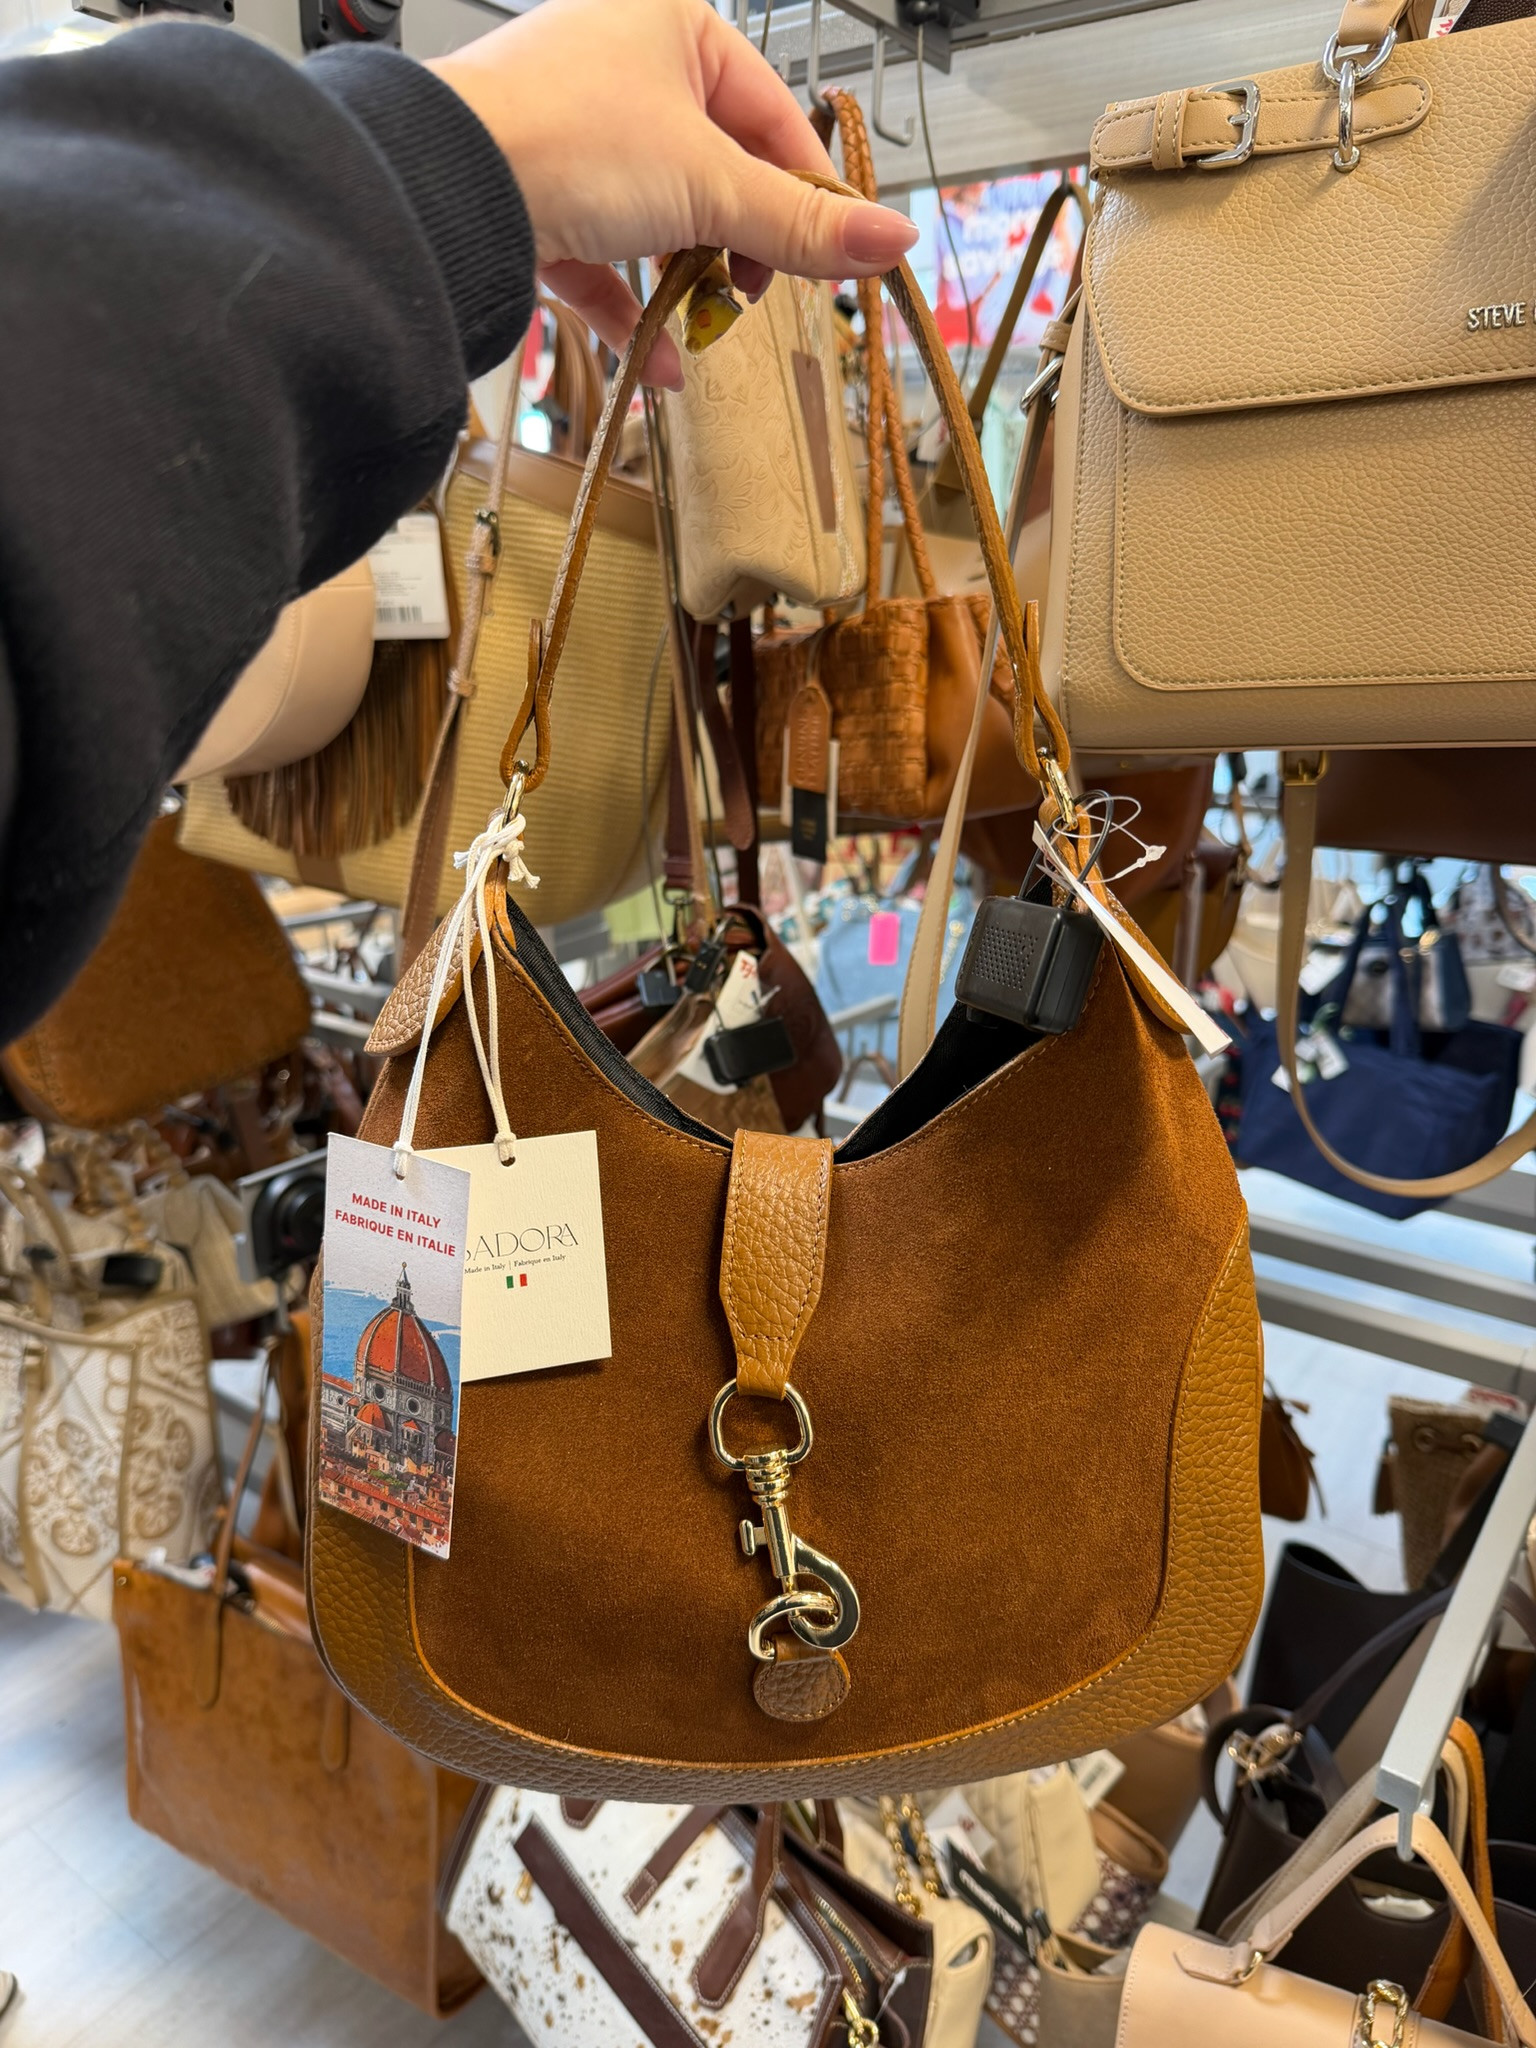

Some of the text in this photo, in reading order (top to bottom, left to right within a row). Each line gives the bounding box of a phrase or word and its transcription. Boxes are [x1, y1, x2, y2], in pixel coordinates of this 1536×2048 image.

[1467, 301, 1527, 330] STEVE
[351, 1193, 441, 1229] MADE IN ITALY
[335, 1209, 456, 1257] FABRIQUE EN ITALIE
[464, 1266, 482, 1274] Made
[492, 1262, 506, 1271] Italy
[514, 1259, 541, 1267] Fabrique
[552, 1254, 566, 1262] Italy
